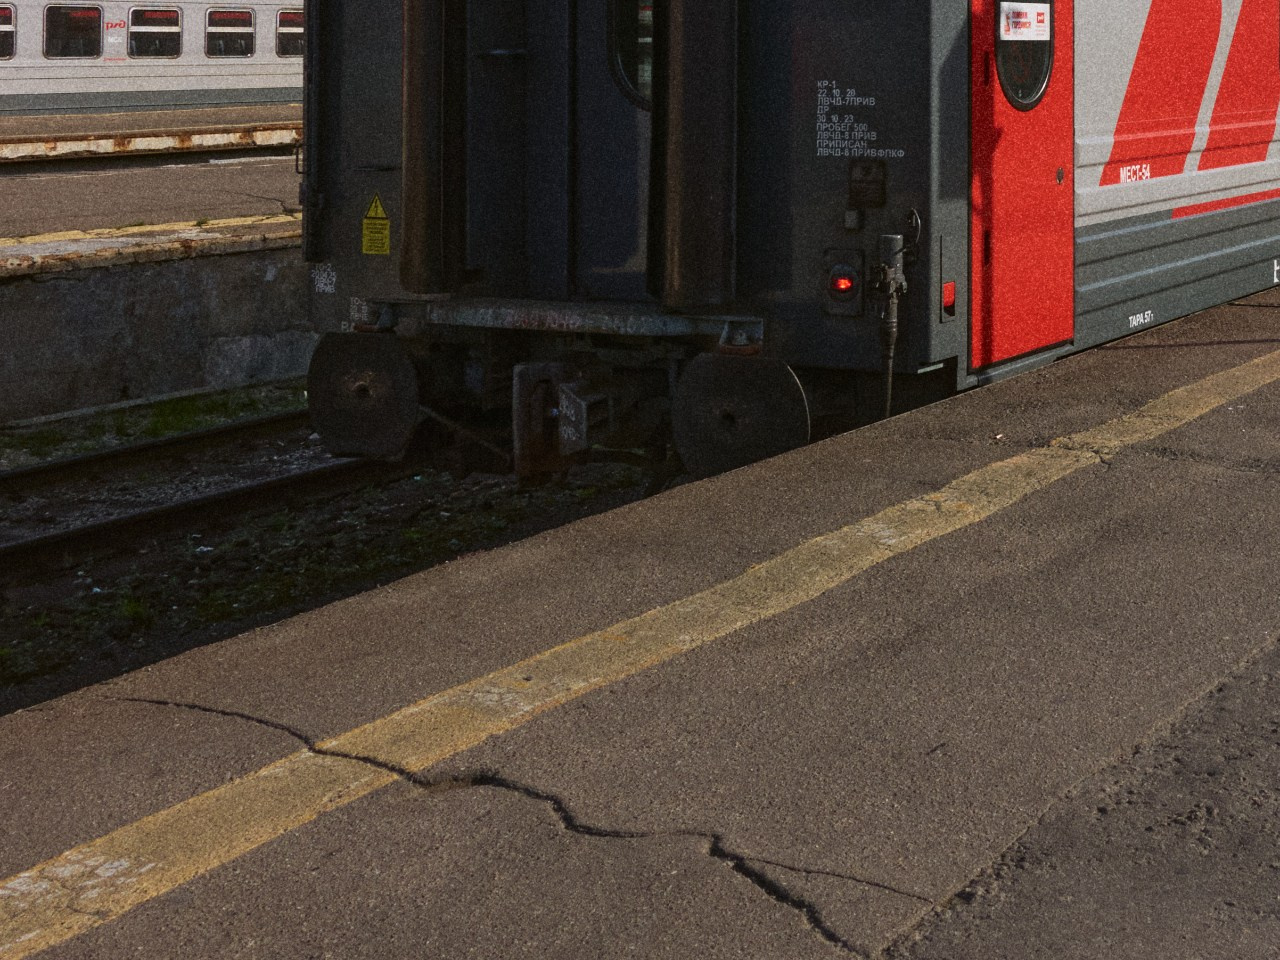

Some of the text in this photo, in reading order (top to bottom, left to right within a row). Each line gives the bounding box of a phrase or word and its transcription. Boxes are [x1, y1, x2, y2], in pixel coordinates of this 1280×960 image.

[817, 80, 836, 88] КР-1
[817, 106, 830, 114] ДР
[816, 123, 868, 132] ПРОБЕГ 500
[851, 131, 877, 140] ПРИВ
[1120, 163, 1151, 183] МЕСТ-54
[1129, 313, 1145, 328] ТАРА
